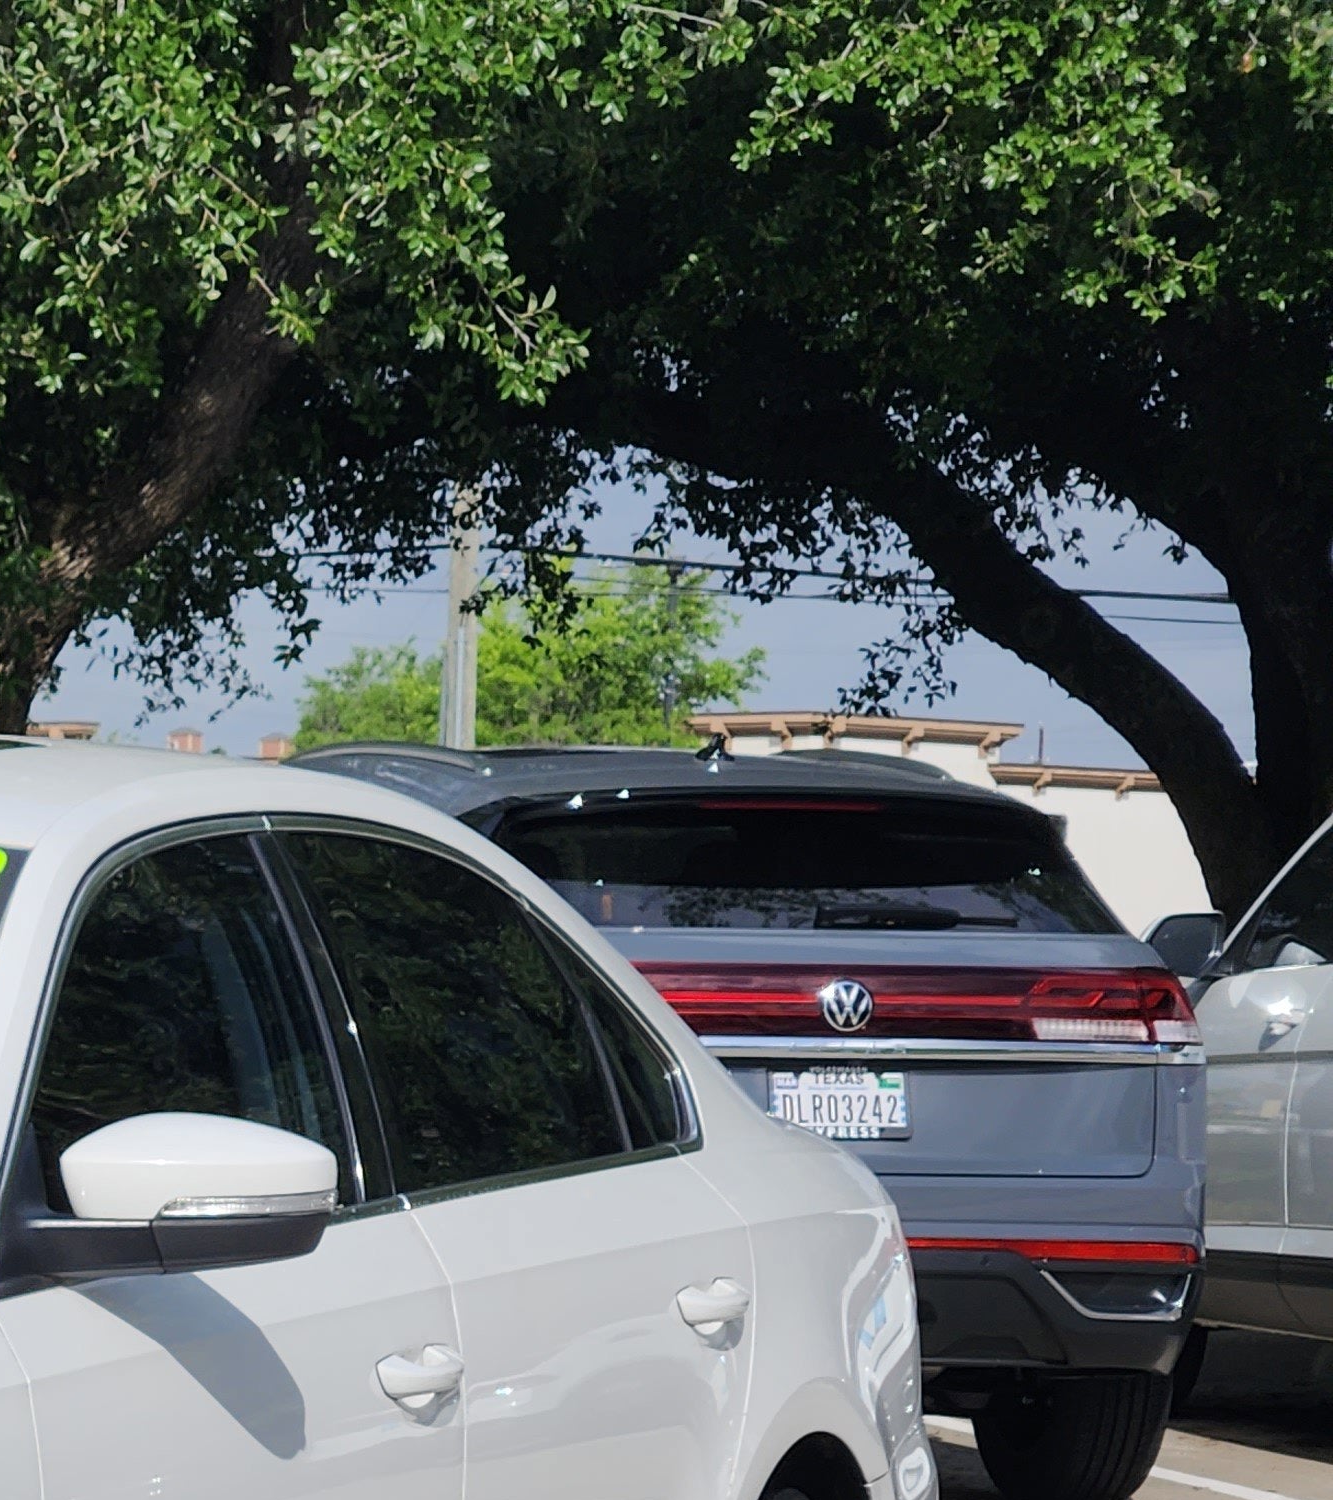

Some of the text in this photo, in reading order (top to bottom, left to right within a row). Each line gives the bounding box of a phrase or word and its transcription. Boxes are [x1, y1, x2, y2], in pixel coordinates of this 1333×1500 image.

[813, 1073, 865, 1085] TEXAS
[782, 1094, 899, 1124] DLR03242
[809, 1126, 880, 1139] YPRESS
